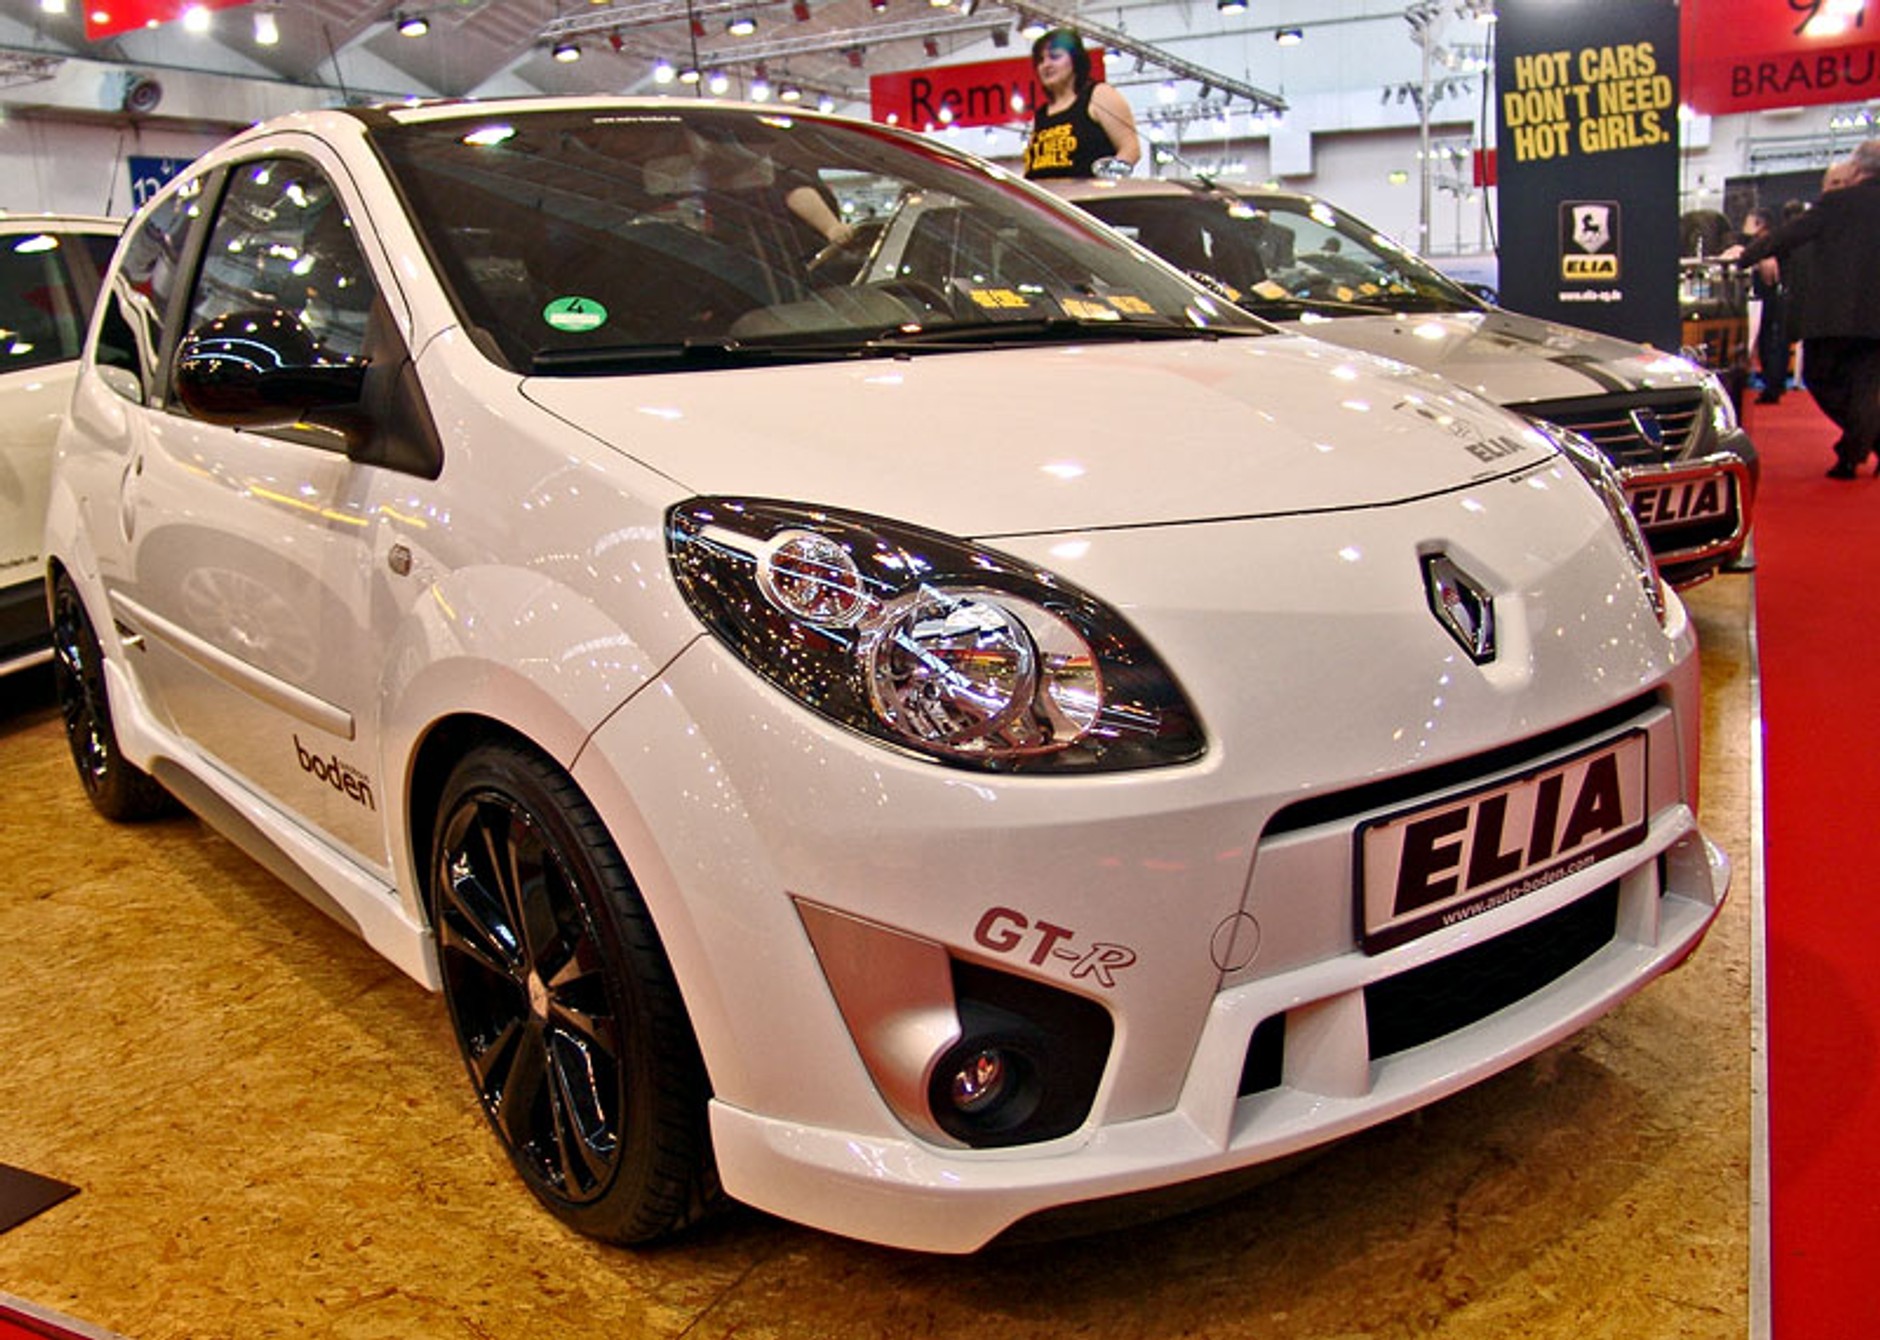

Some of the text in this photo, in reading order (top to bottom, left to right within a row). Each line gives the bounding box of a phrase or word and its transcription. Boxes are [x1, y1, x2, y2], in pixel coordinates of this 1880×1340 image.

[1514, 41, 1657, 91] HOT CARS
[1730, 50, 1880, 98] BRABU
[908, 77, 1036, 125] Remu
[1503, 74, 1673, 127] DON'T NEED
[1514, 110, 1671, 162] HOT GIRLS.
[1566, 260, 1614, 273] ELIA
[565, 298, 585, 314] 4
[1464, 436, 1528, 464] ELIA
[1632, 479, 1720, 526] ELIA
[293, 733, 376, 812] boden
[1392, 752, 1624, 918] ELIA
[1442, 854, 1596, 926] www.auto-boden.com
[973, 906, 1137, 989] GT-R
